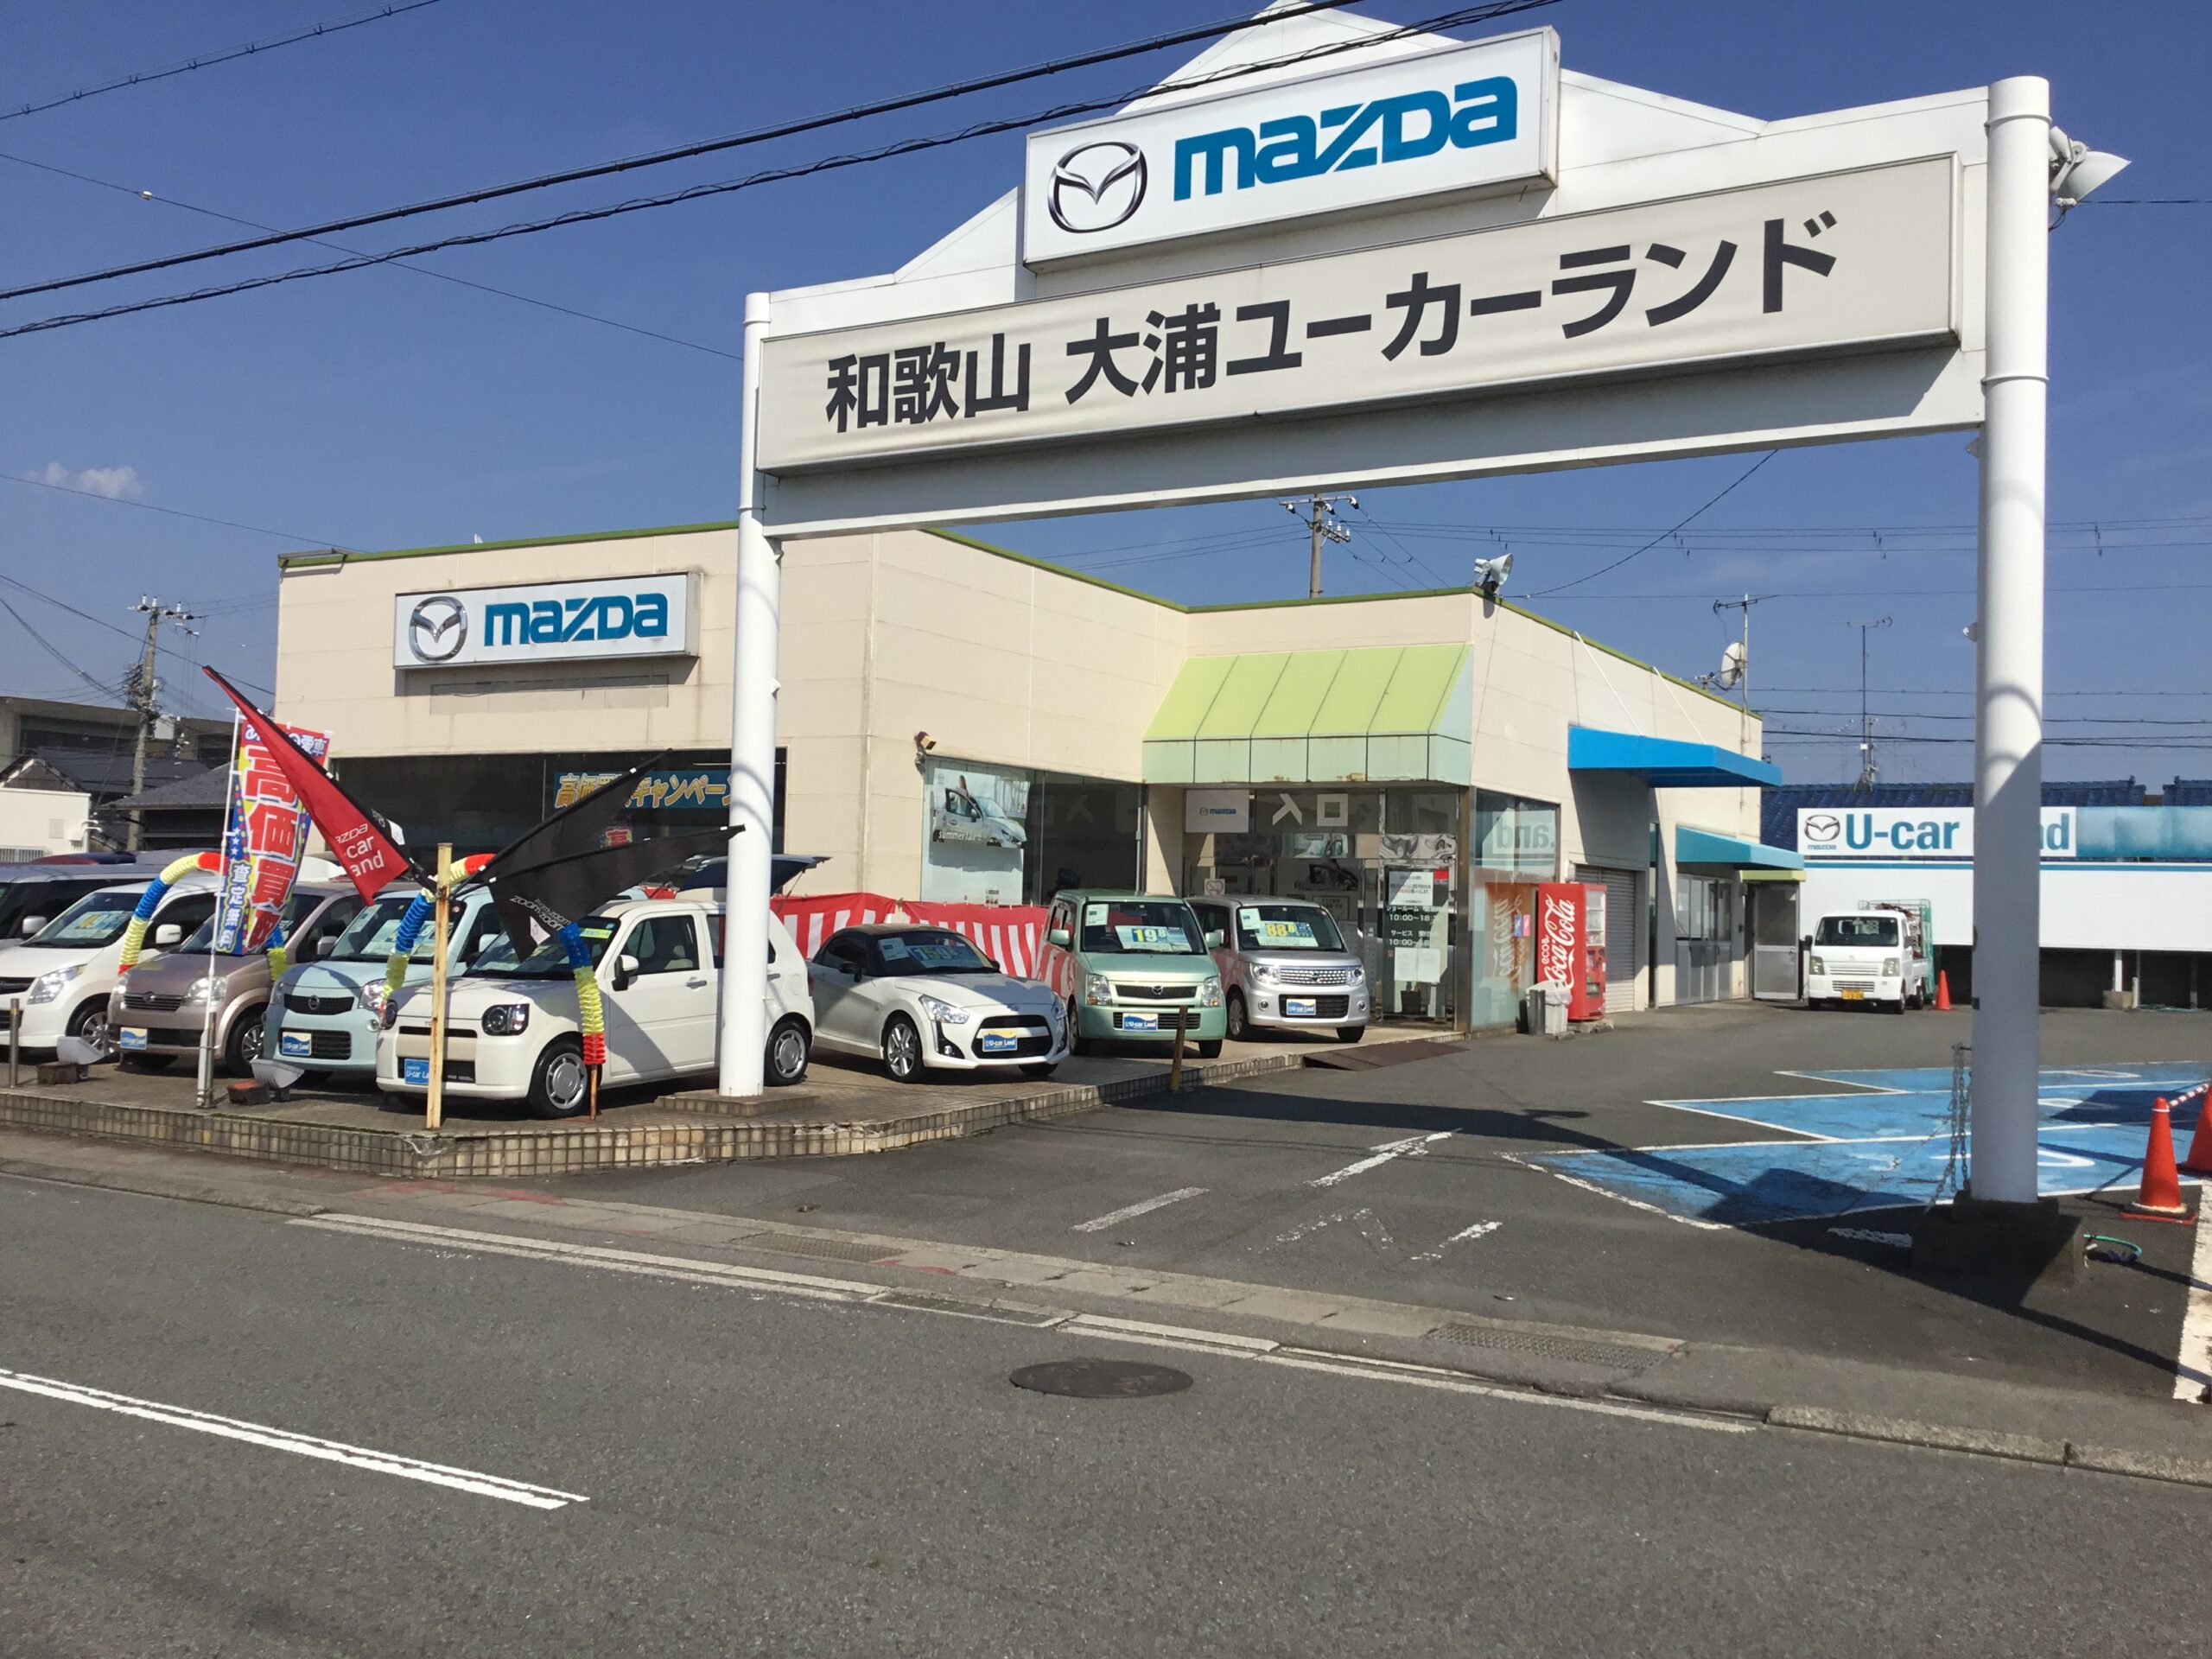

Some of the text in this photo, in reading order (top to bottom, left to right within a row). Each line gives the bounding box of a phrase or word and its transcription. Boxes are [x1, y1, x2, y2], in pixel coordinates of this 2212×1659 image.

[1173, 75, 1518, 202] mazda
[825, 210, 1838, 434] 和歌山 大浦ユーカーランド
[483, 593, 669, 647] mazda
[554, 772, 731, 809] 高価キャンペー
[1272, 793, 1349, 827] 入口
[1846, 813, 1961, 850] U-car
[217, 864, 252, 950] 査定無料
